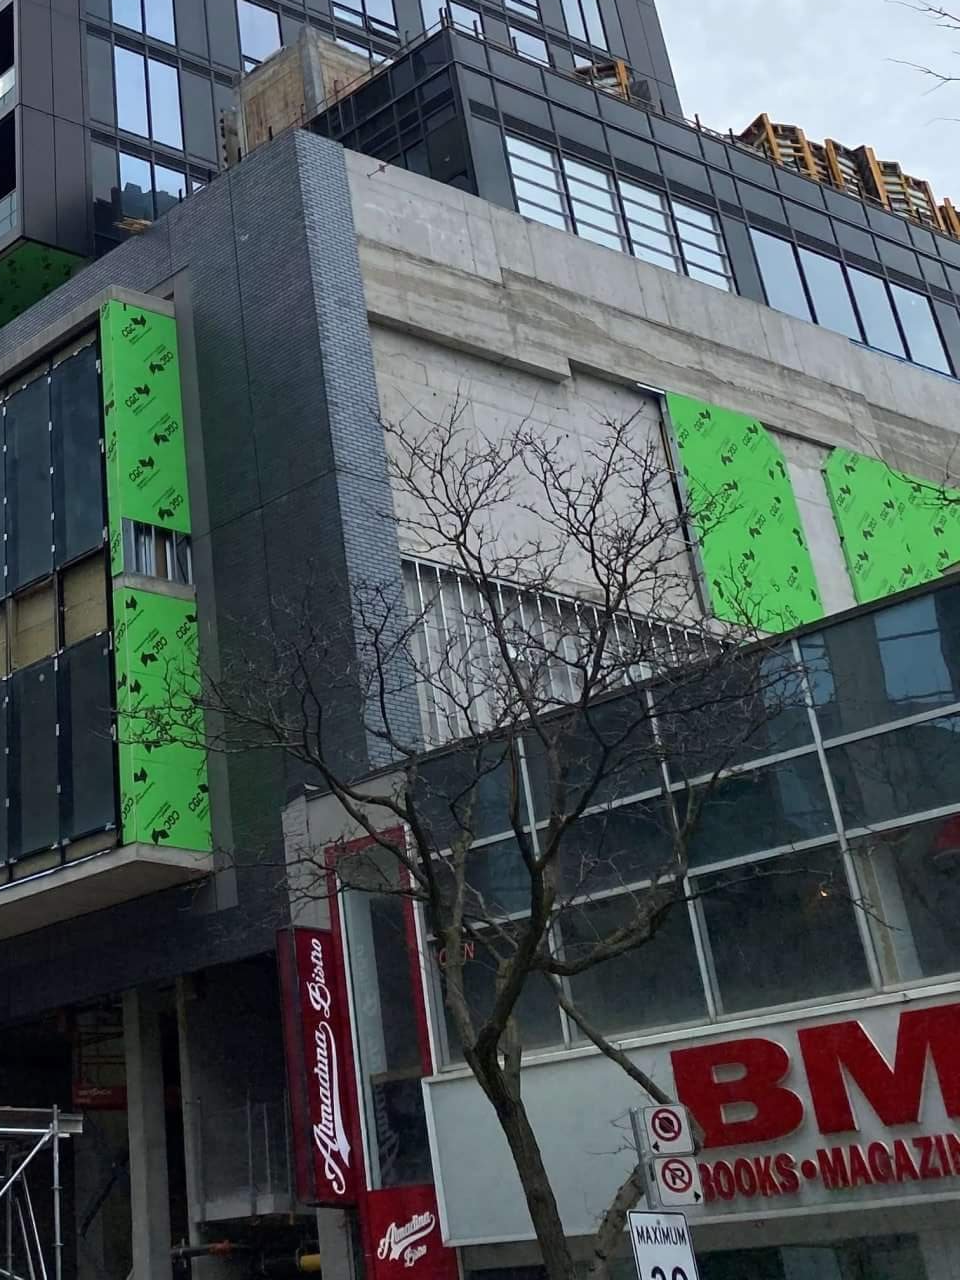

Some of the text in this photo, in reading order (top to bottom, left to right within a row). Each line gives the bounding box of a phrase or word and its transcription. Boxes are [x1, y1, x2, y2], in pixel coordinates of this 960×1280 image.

[306, 938, 352, 1194] Almadina Bistro
[635, 1226, 688, 1246] MAXIMUM
